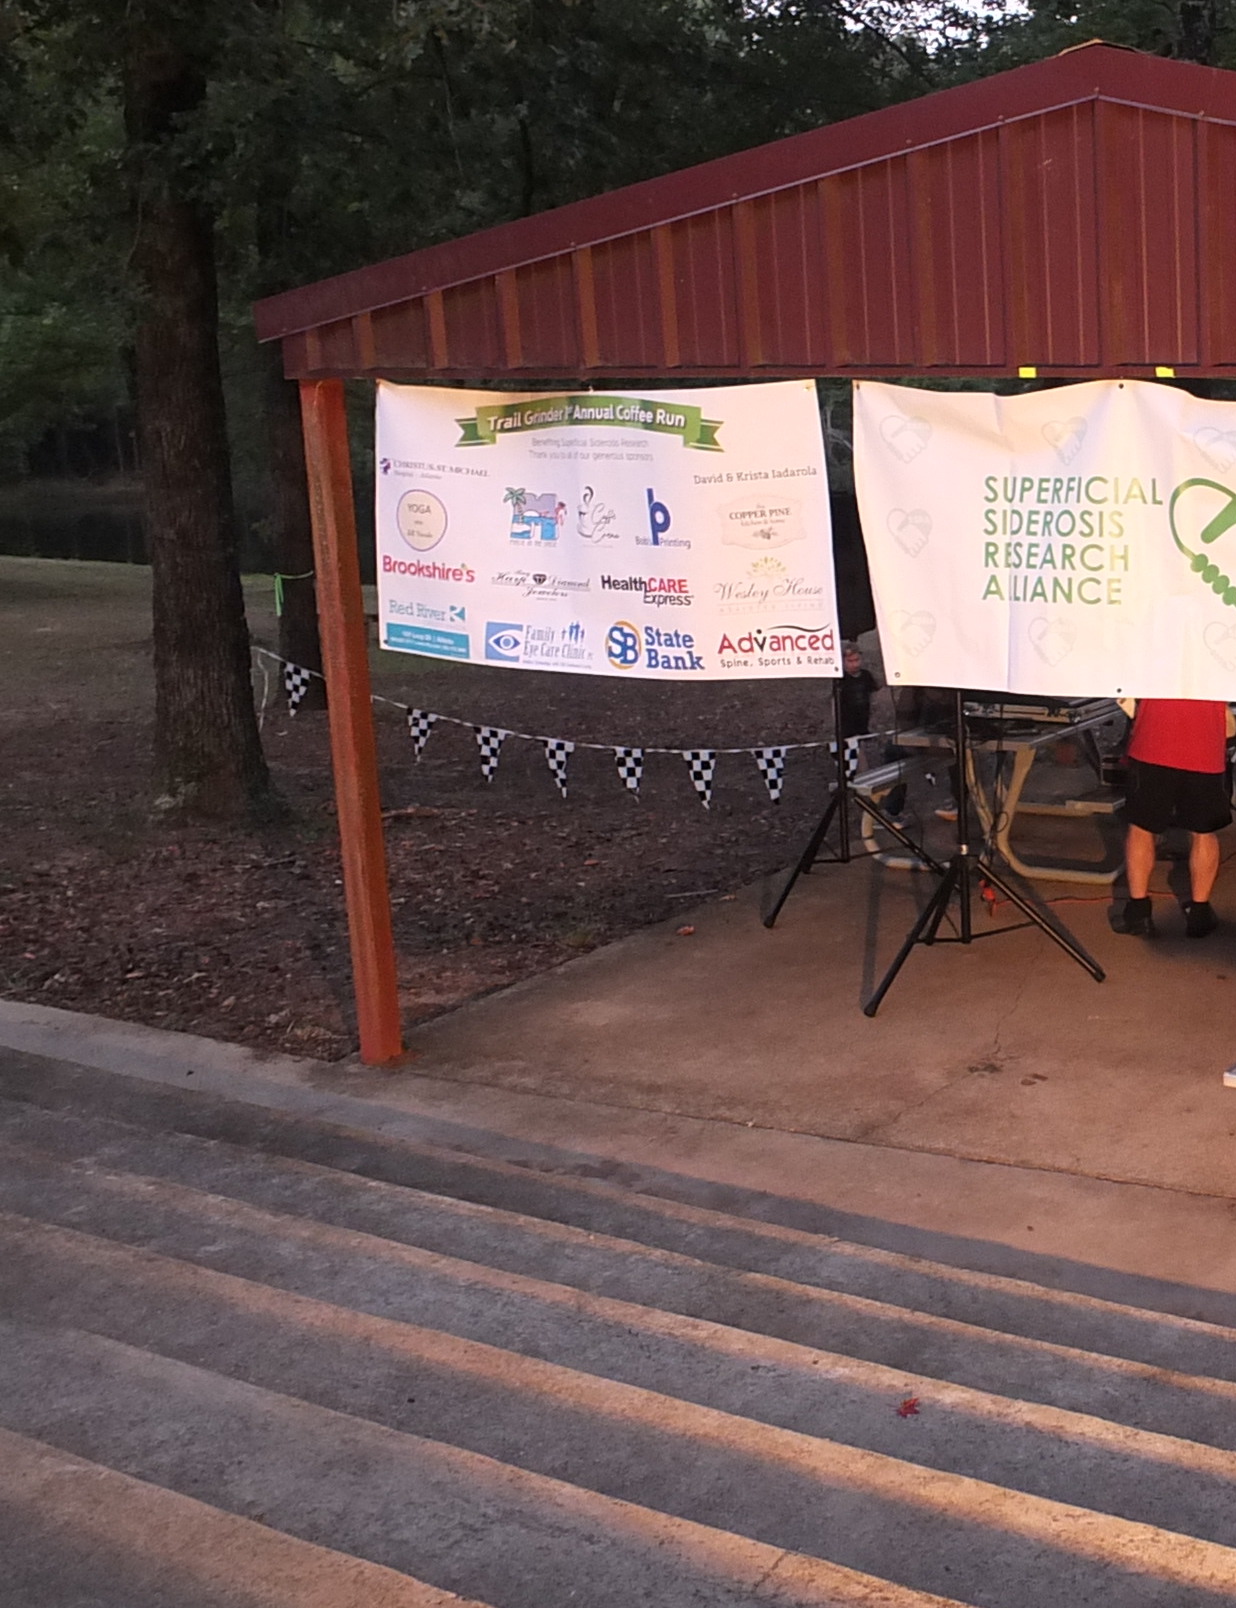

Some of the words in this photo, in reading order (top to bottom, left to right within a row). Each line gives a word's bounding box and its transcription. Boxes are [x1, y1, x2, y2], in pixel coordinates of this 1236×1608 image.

[487, 412, 522, 431] Trail
[524, 407, 564, 426] Grinder
[573, 404, 614, 420] Annual
[616, 405, 654, 423] Coffee
[655, 407, 686, 427] Run
[693, 474, 724, 485] David
[726, 473, 734, 482] &
[736, 470, 770, 481] Krista
[772, 465, 818, 479] Iadarola
[983, 475, 1164, 506] SUPERFICIAL
[407, 503, 432, 514] YOGA
[729, 510, 767, 521] COPPER
[768, 507, 791, 518] PINE
[983, 509, 1125, 539] SIDEROSIS
[660, 537, 691, 550] Printing
[984, 542, 1130, 573] RESEARCH
[382, 555, 476, 583] Brookshire's
[600, 575, 690, 594] HealthCARE
[714, 582, 770, 604] Wesley
[773, 578, 823, 596] House
[388, 599, 414, 616] Red
[416, 603, 446, 621] River
[643, 594, 692, 608] Express
[526, 624, 555, 642] Family
[644, 626, 694, 648] State
[717, 627, 835, 655] Advanced
[523, 640, 539, 658] Eye
[541, 642, 560, 658] Care
[561, 643, 586, 659] Clinic
[607, 625, 640, 665] SB
[646, 648, 705, 670] Bank
[720, 658, 753, 668] Spine,
[758, 656, 791, 668] Sports
[796, 656, 802, 666] &
[807, 655, 835, 666] Rehab
